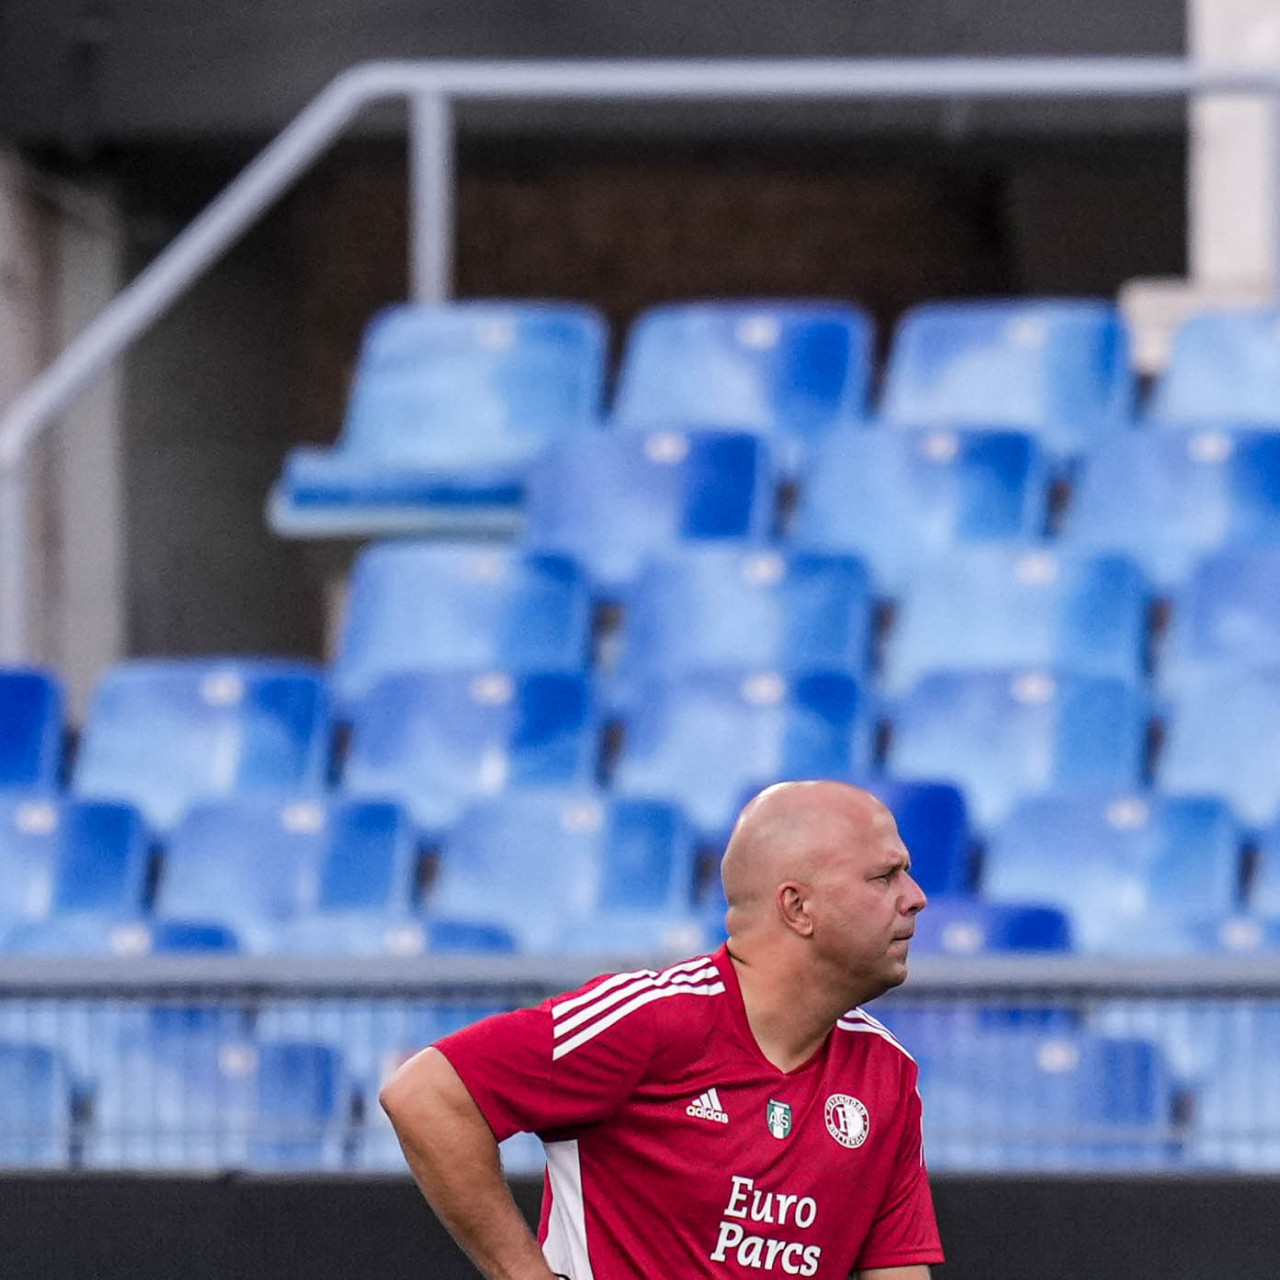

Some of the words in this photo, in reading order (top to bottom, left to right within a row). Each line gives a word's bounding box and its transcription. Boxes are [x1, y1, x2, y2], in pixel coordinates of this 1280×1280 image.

[686, 1105, 729, 1124] adidas
[723, 1175, 817, 1229] Euro
[709, 1221, 822, 1277] Parcs
